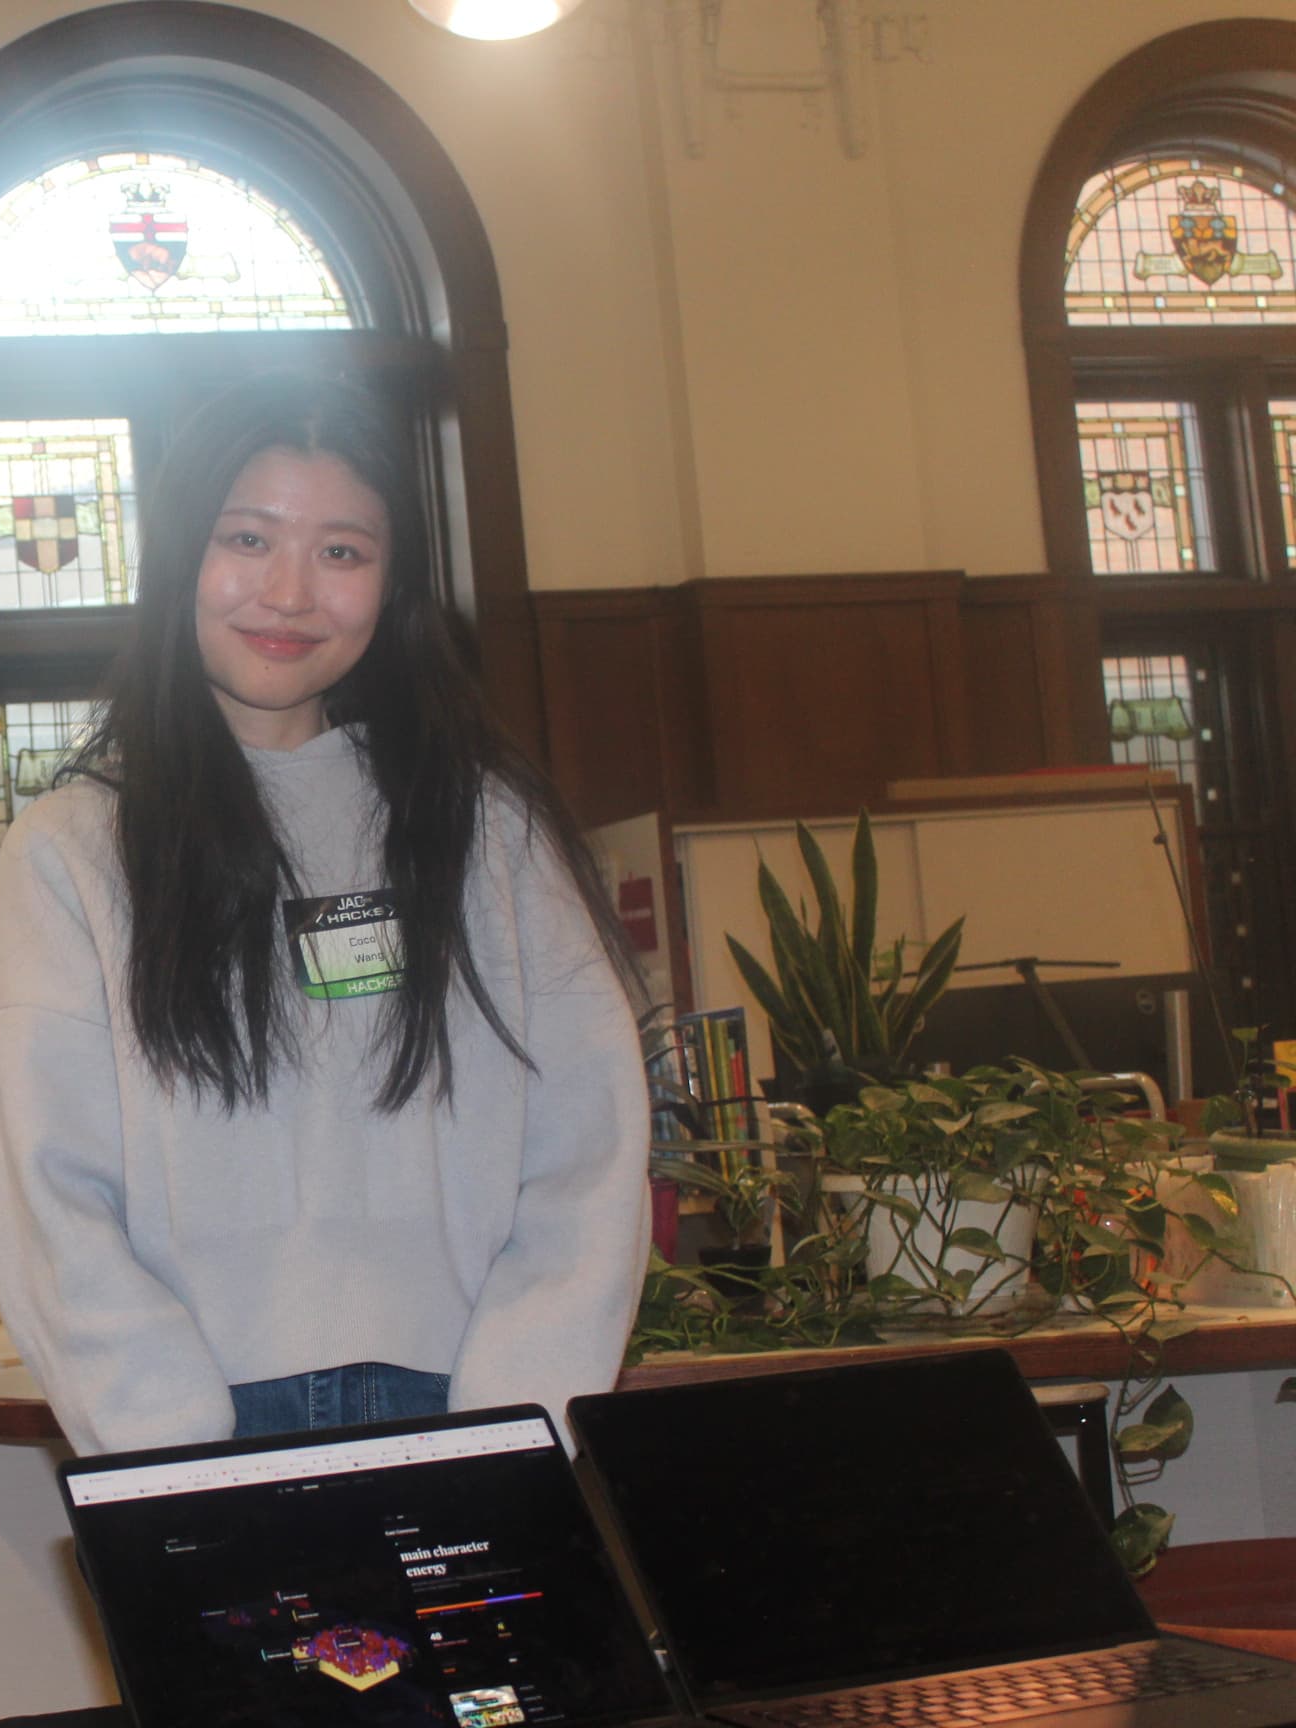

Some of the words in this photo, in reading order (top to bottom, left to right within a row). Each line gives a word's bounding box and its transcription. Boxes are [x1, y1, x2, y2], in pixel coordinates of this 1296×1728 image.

[349, 935, 376, 947] Coco
[354, 952, 385, 963] Wang
[400, 1547, 432, 1562] main
[432, 1541, 489, 1557] character
[406, 1563, 447, 1577] energy
